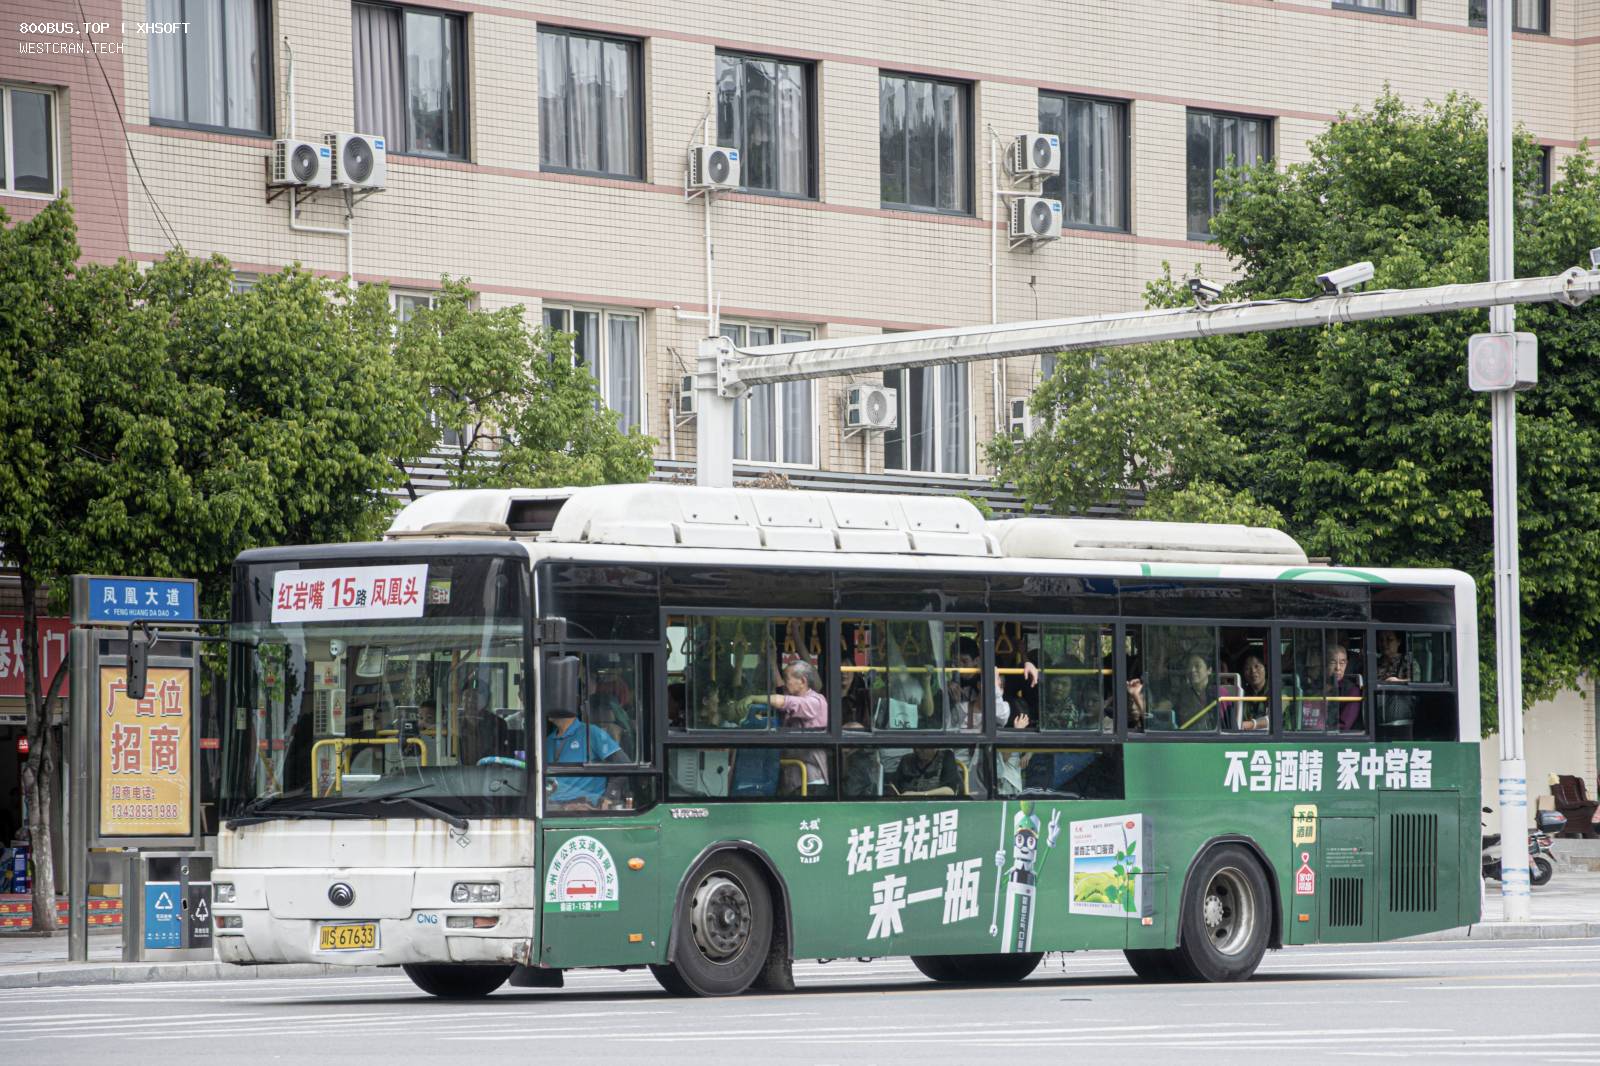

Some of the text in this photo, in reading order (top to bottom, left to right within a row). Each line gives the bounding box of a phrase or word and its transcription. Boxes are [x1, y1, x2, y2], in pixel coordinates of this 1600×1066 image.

[103, 586, 180, 606] 凤凰大道
[277, 580, 325, 611] 红岩嘴
[371, 576, 419, 607] 凤凰头
[113, 608, 128, 616] FENG
[111, 723, 180, 774] 招商
[1224, 748, 1433, 793] 不含酒精 家中常备
[111, 804, 178, 819] 13438551988
[1297, 811, 1314, 823] 不含
[1295, 825, 1313, 838] 酒精
[846, 808, 959, 876] 祛暑祛湿
[866, 857, 983, 940] 来一瓶
[416, 913, 438, 924] CNG
